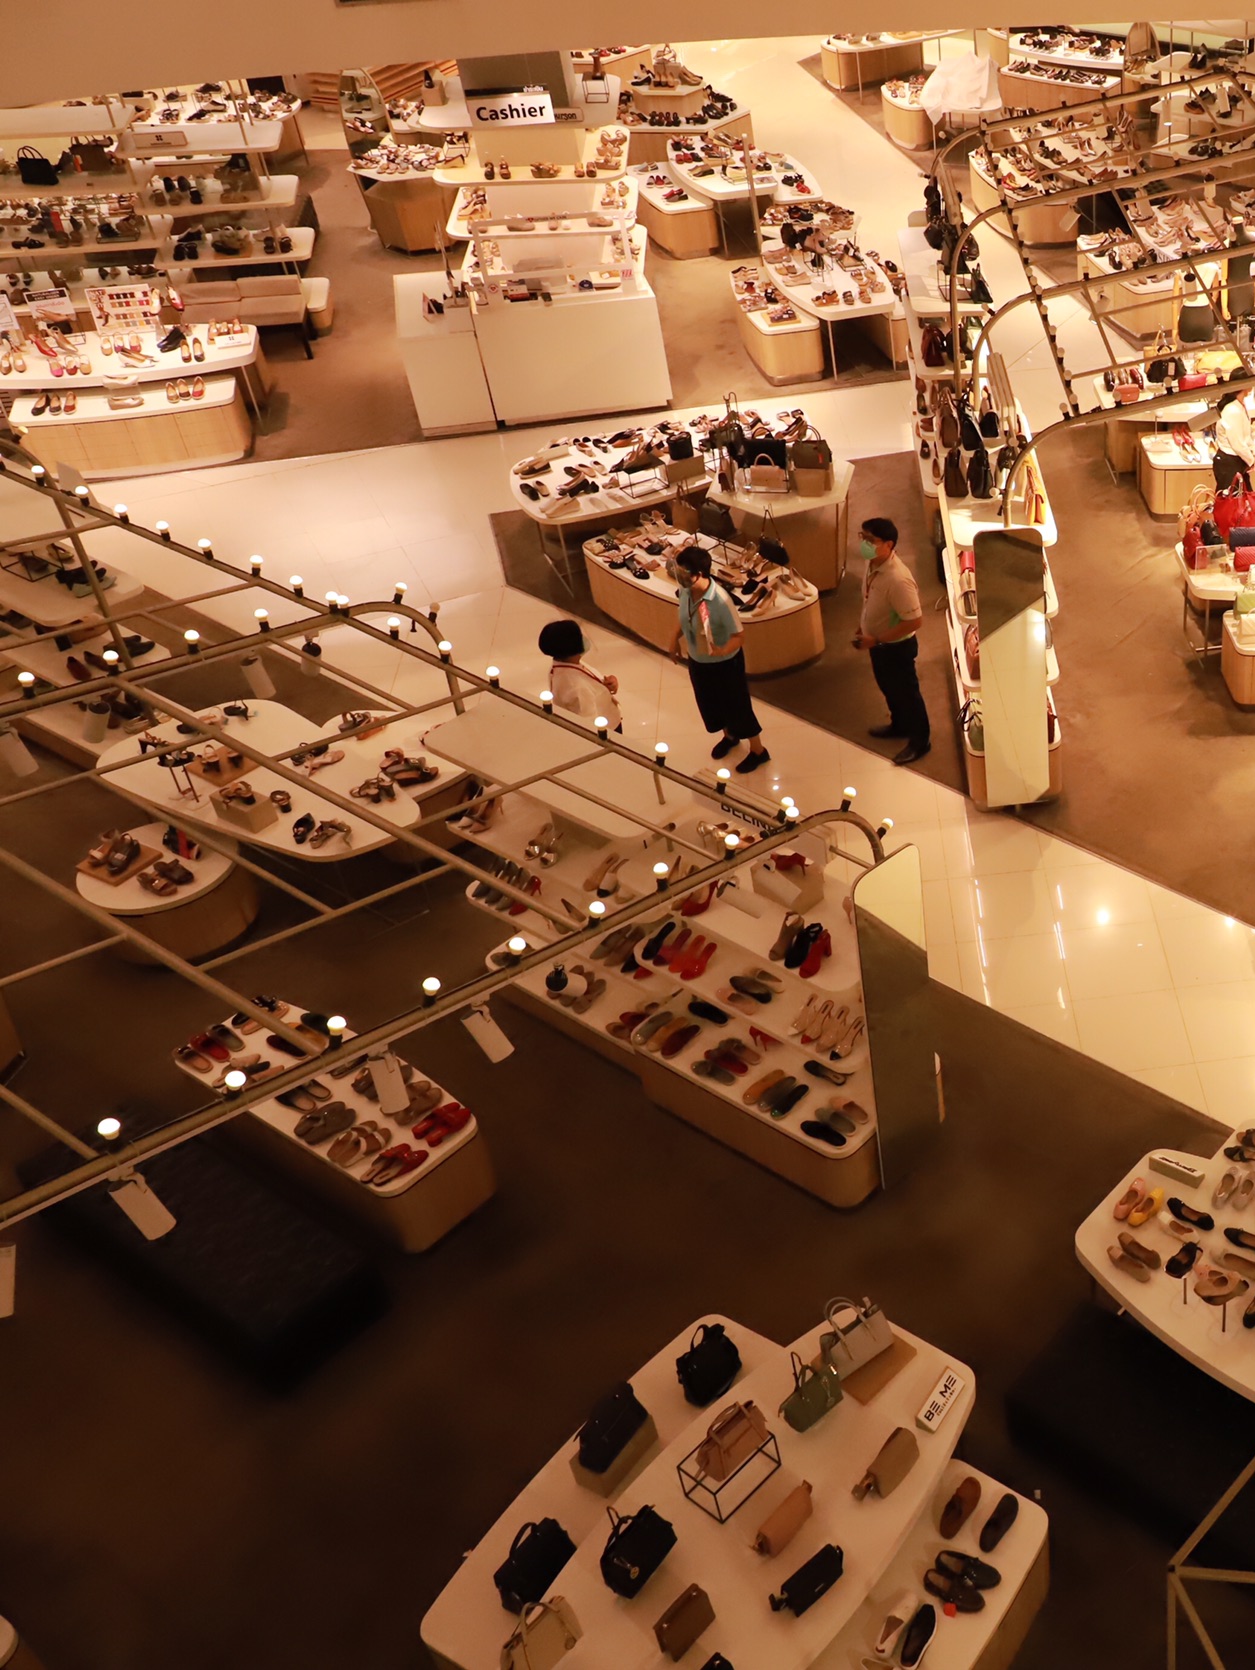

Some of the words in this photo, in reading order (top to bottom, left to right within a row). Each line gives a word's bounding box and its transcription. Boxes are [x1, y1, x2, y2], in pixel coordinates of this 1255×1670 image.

[476, 103, 546, 121] Cashier
[924, 1400, 940, 1422] BE
[939, 1375, 957, 1398] ME
